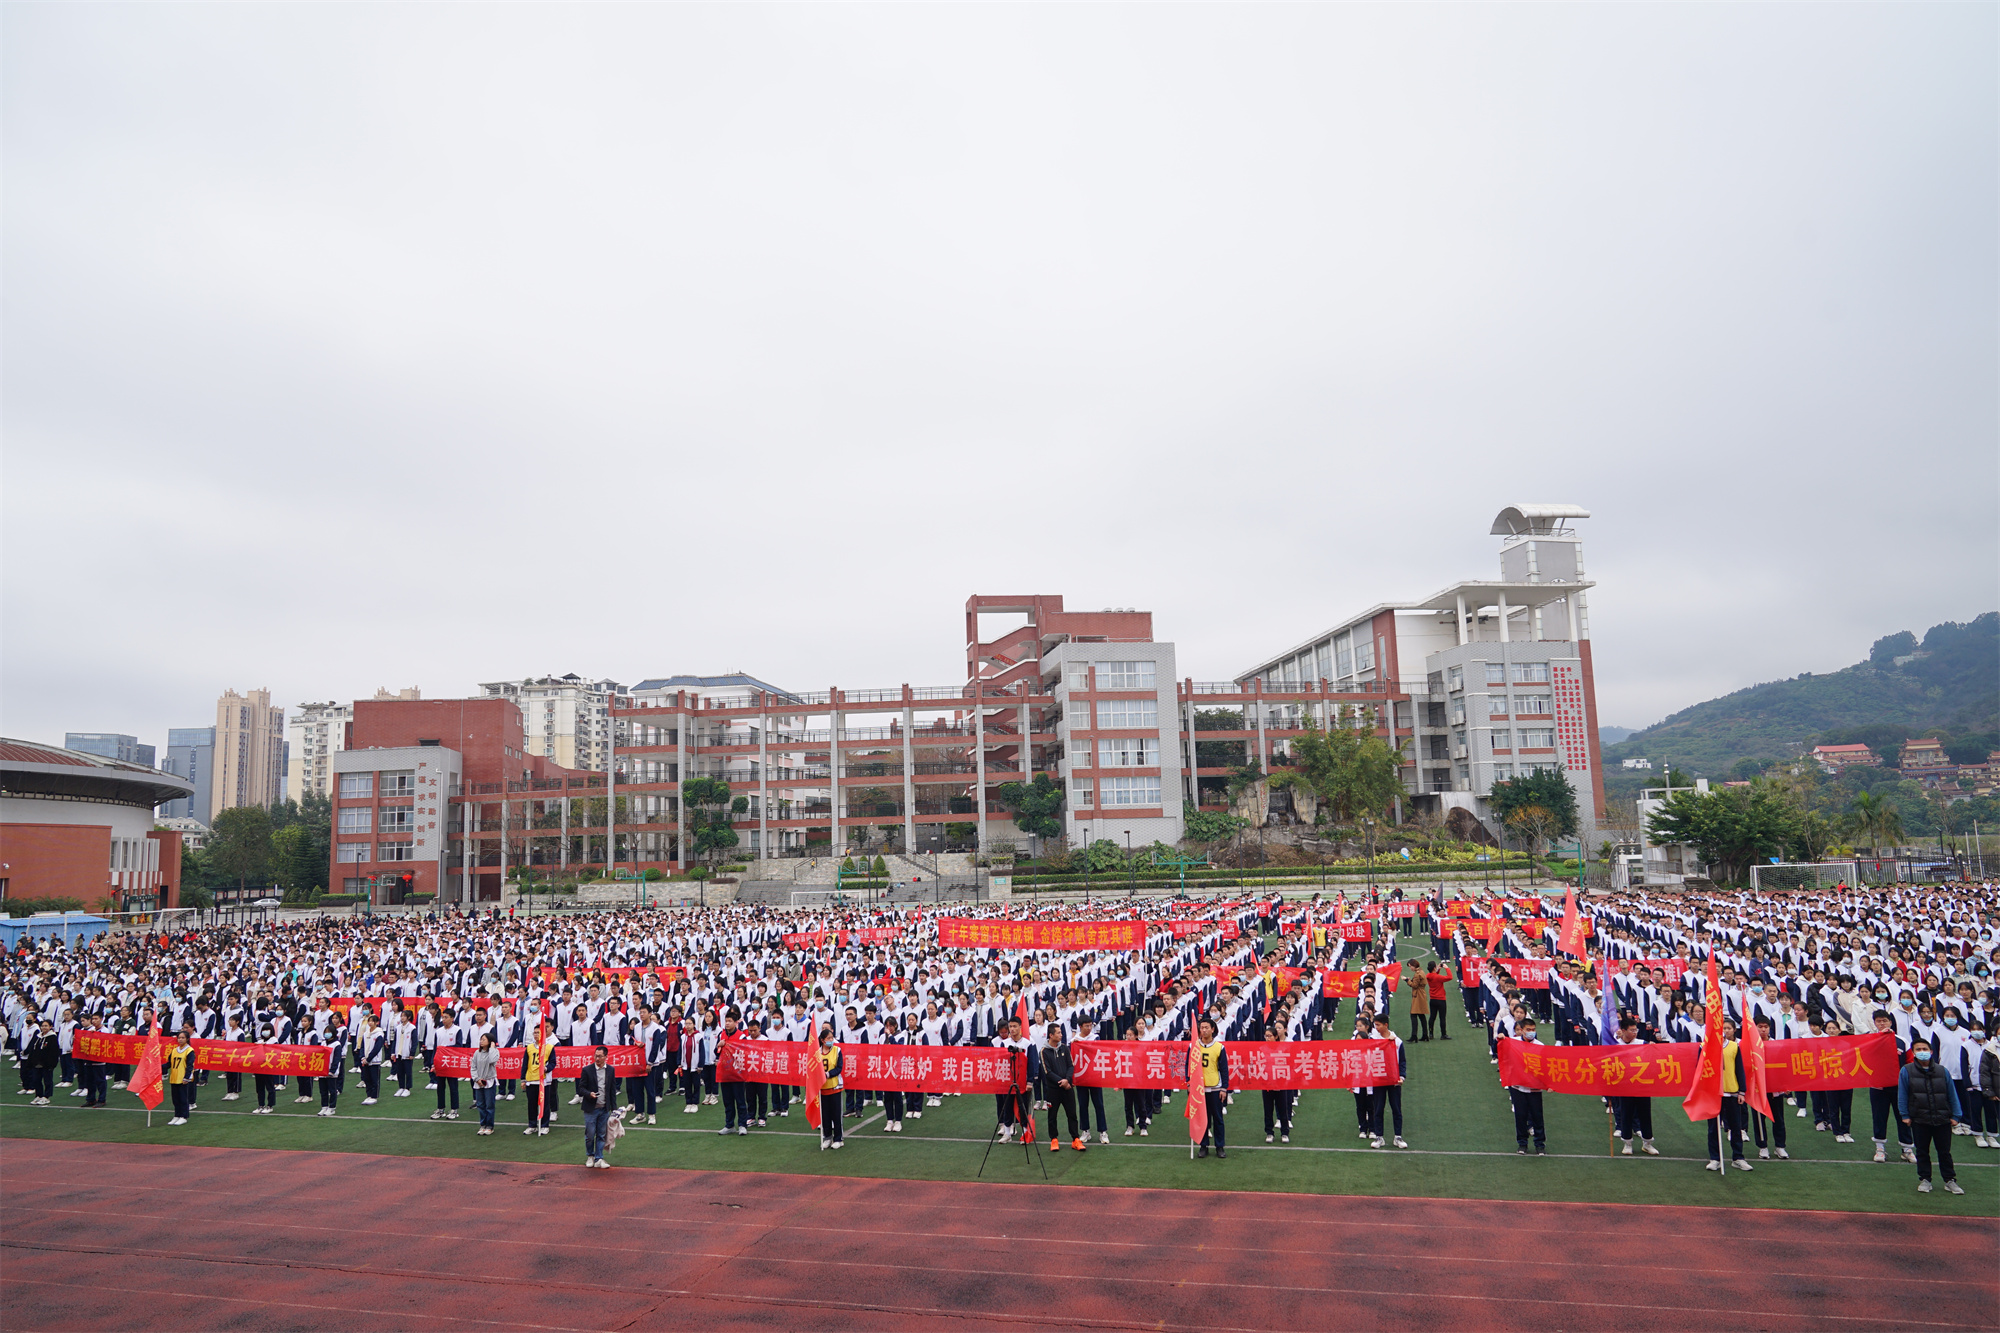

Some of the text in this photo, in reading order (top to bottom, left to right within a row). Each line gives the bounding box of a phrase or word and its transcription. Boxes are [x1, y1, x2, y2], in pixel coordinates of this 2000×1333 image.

[949, 923, 1134, 945] 十年寒窗百炼成钢 金榜夺魁舍我其谁
[80, 1036, 126, 1060] 鲲鹏北海
[197, 1045, 255, 1067] 高三十七
[260, 1049, 325, 1072] 文采飞扬
[172, 1056, 182, 1069] 17
[605, 1053, 640, 1067] 上211
[732, 1051, 790, 1075] 雄关漫道
[942, 1057, 1011, 1083] 我自称雄
[1073, 1049, 1134, 1079] 少年狂
[1201, 1053, 1210, 1068] 5
[1522, 1051, 1682, 1086] 厚积分秒之功
[1765, 1047, 1874, 1080] 一鸣惊人
